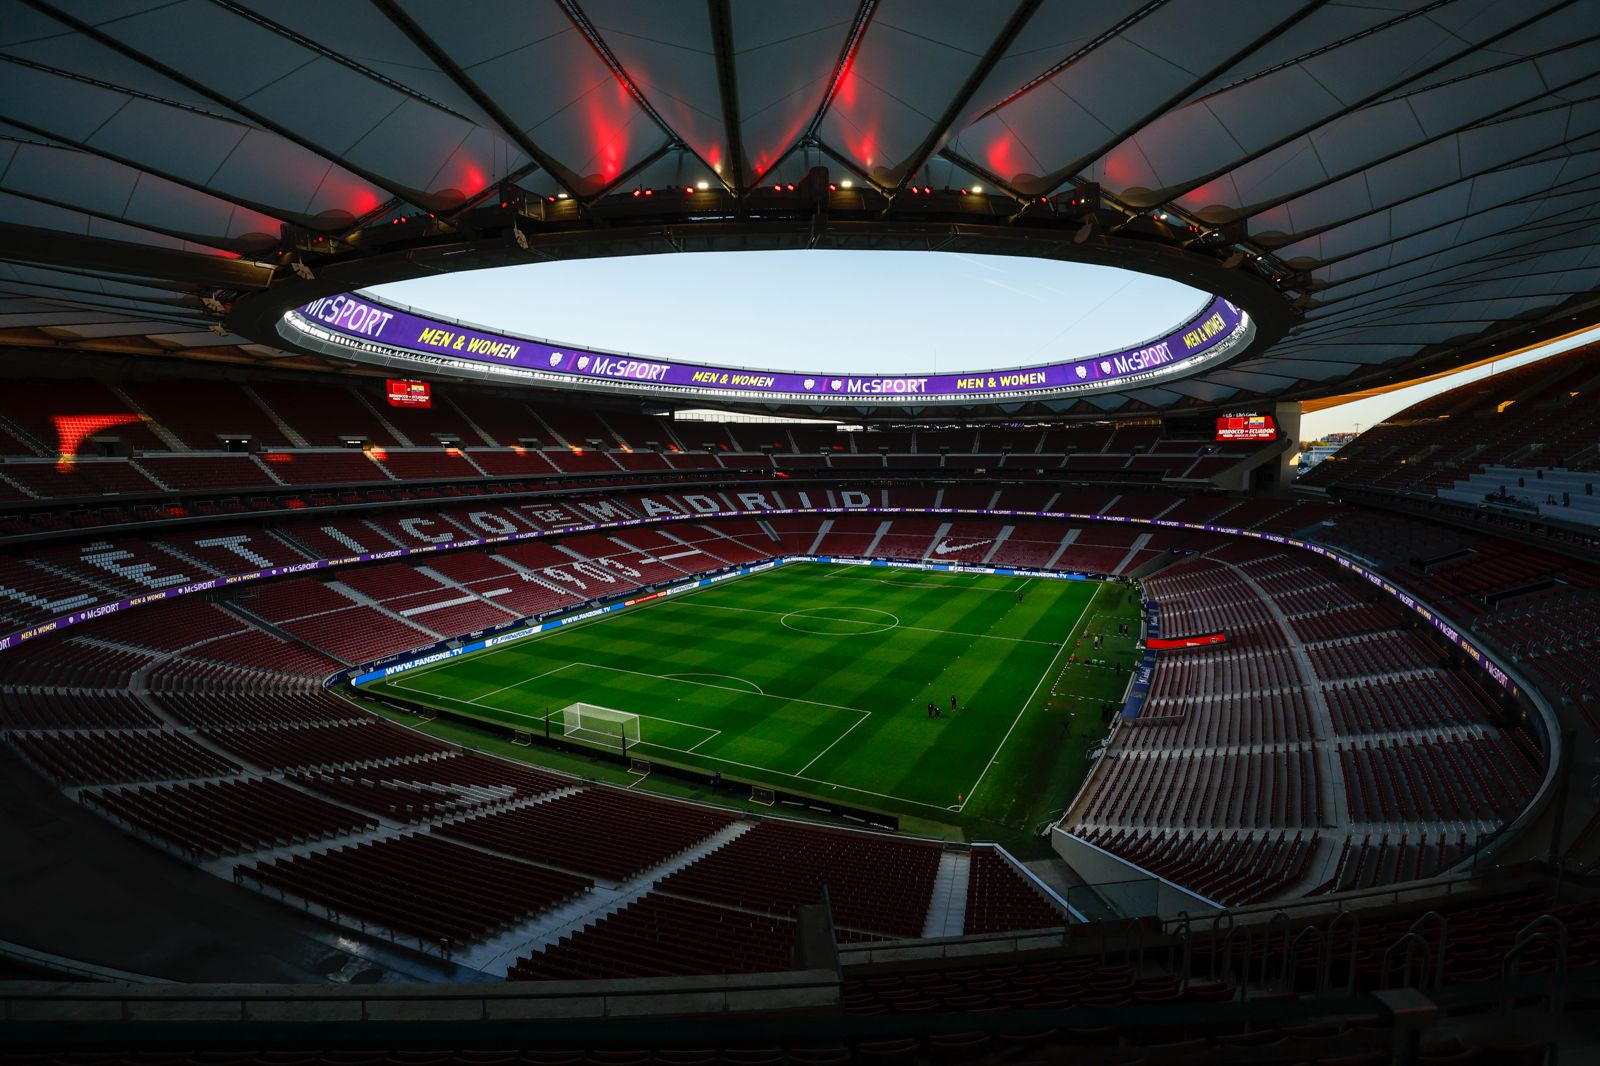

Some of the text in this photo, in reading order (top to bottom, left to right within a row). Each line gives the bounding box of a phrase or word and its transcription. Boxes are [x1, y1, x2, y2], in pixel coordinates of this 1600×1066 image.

[305, 295, 520, 359] McSPORT MEN & WOMEN
[1183, 312, 1227, 349] MEN & WOMEN
[591, 357, 775, 388] McSPORT MEN & WOMEN
[1114, 342, 1174, 374] McSPORT
[847, 372, 1046, 393] McSPORT MEN & WOMEN
[578, 491, 871, 522] MADRID
[289, 561, 319, 573] McSPORT
[185, 580, 215, 593] McSPORT
[87, 603, 119, 619] McSPORT
[386, 647, 463, 675] WWW.FANZONE.TV
